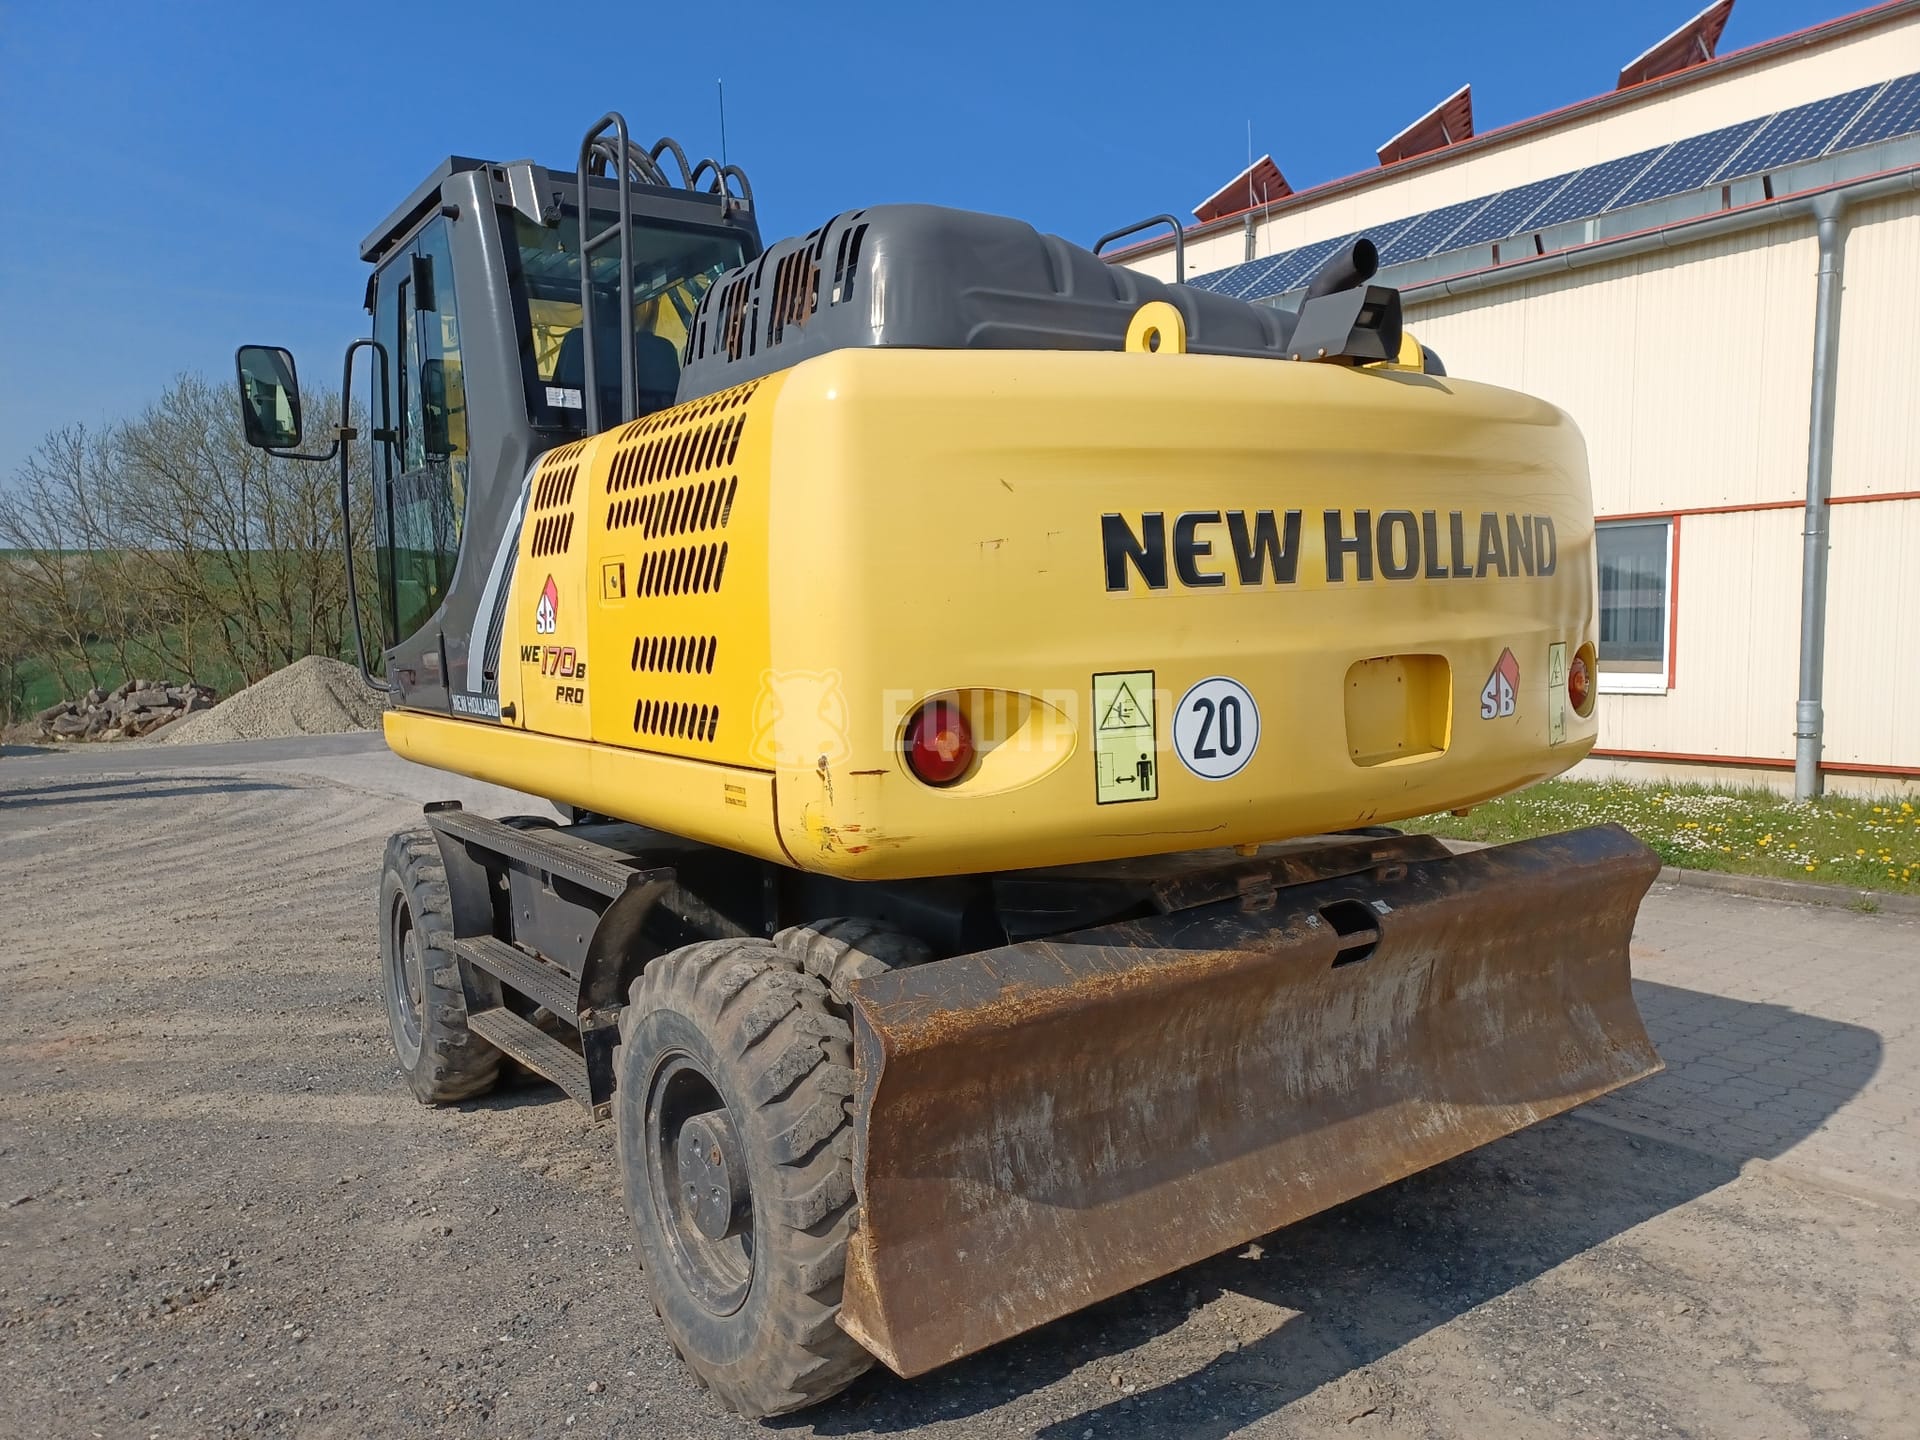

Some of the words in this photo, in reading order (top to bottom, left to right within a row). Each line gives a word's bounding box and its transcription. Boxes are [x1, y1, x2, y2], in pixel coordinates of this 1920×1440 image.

[1101, 510, 1302, 592] NEW
[1323, 509, 1557, 582] HOLLAND
[535, 597, 556, 634] SB
[452, 695, 468, 712] NEW
[467, 696, 499, 717] HOLLAND
[556, 686, 584, 703] PRO
[1481, 674, 1516, 720] SB
[1192, 696, 1241, 760] 20
